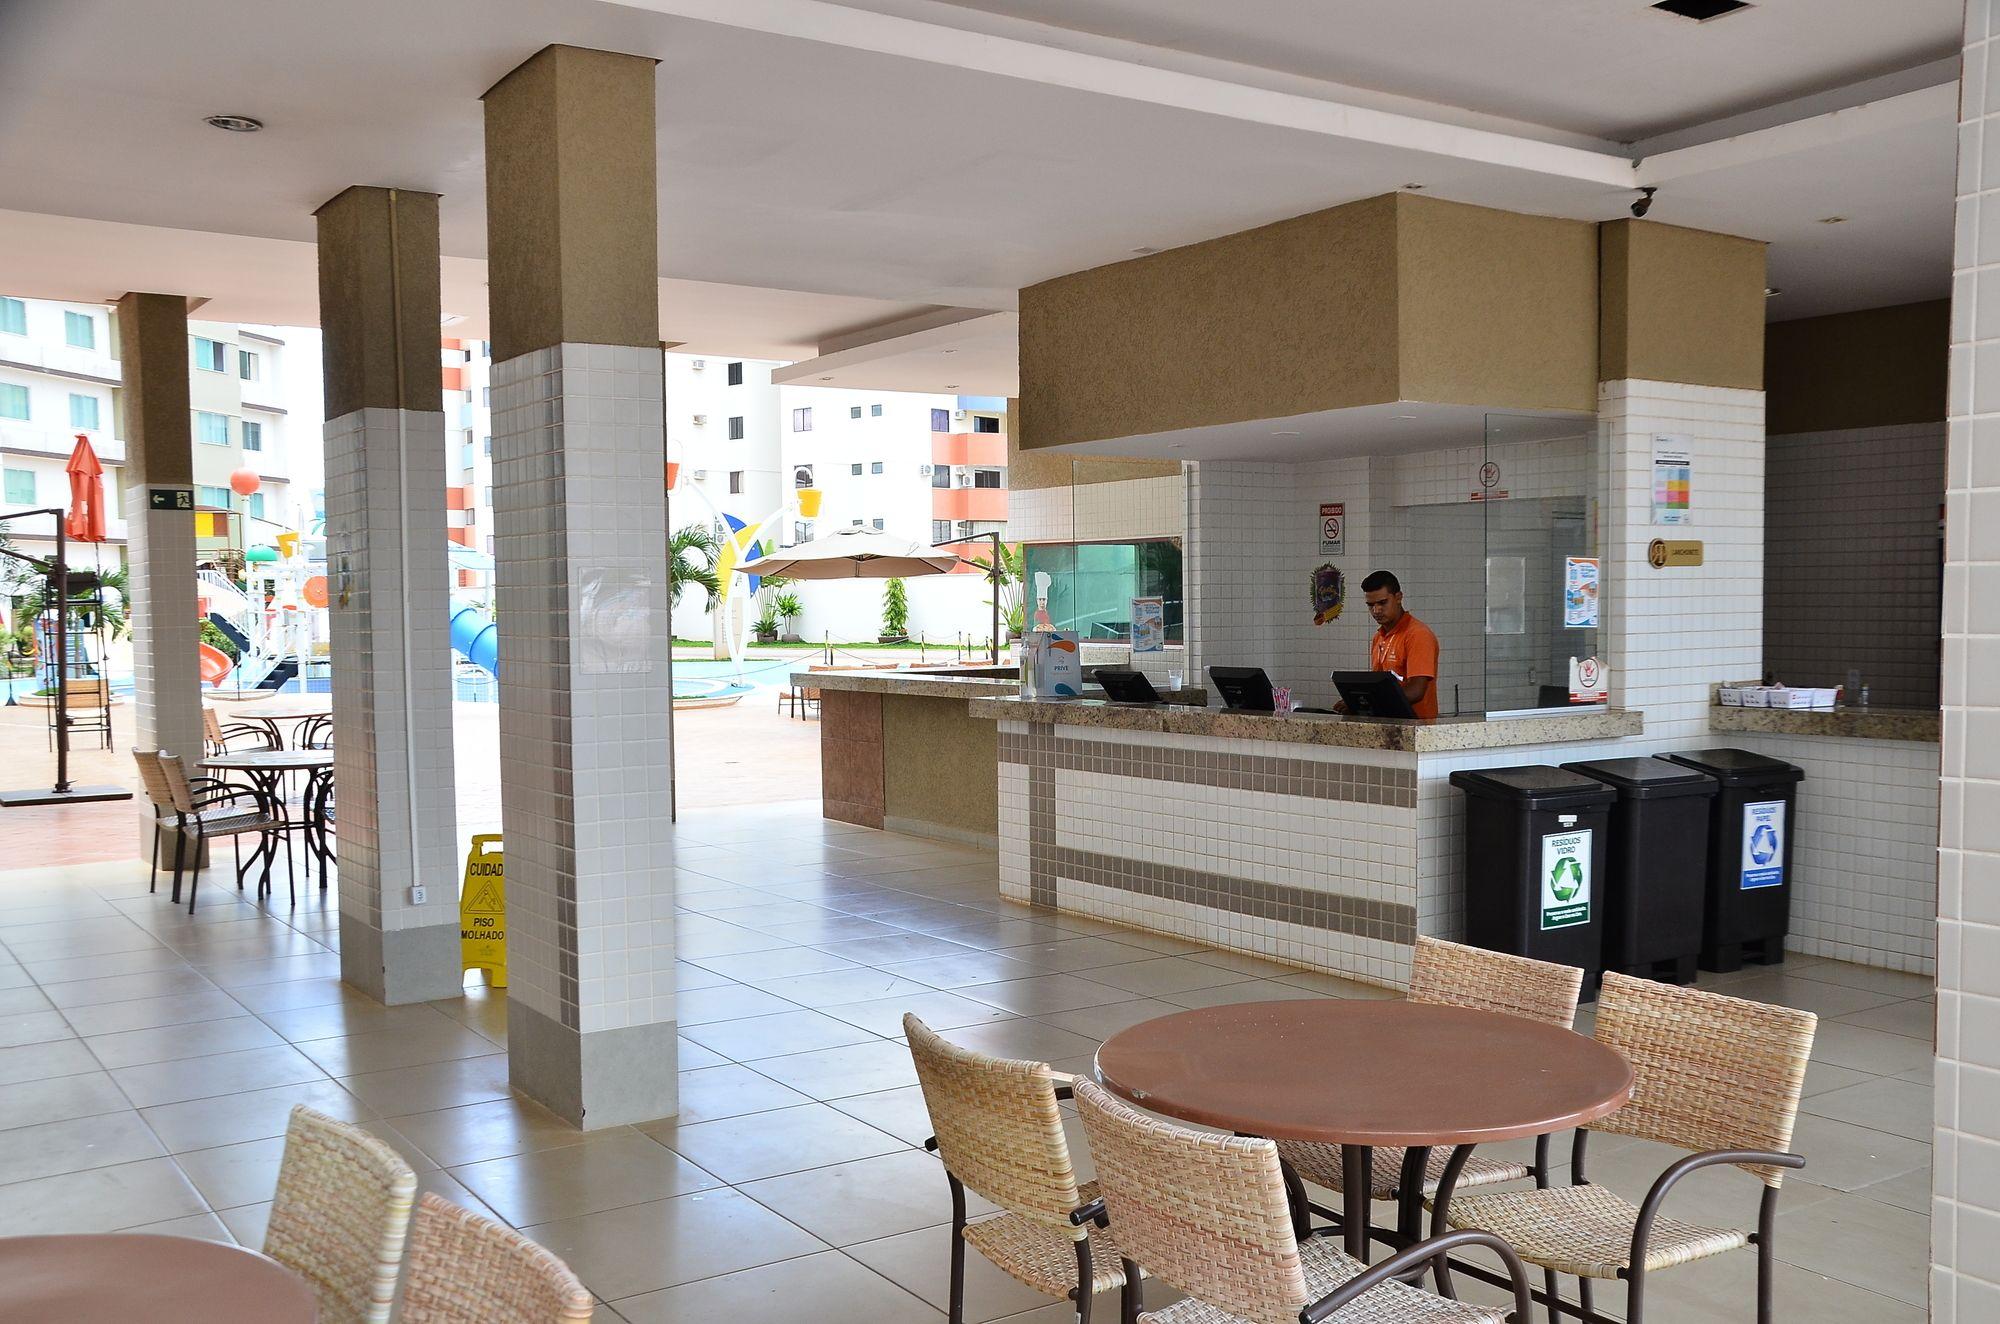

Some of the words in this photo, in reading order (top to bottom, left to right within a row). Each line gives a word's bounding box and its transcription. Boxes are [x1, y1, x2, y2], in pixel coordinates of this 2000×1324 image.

[1557, 846, 1576, 855] VIDRO
[470, 862, 504, 877] CUIDAD
[473, 917, 495, 927] PISO
[461, 930, 505, 940] MOLHADO
